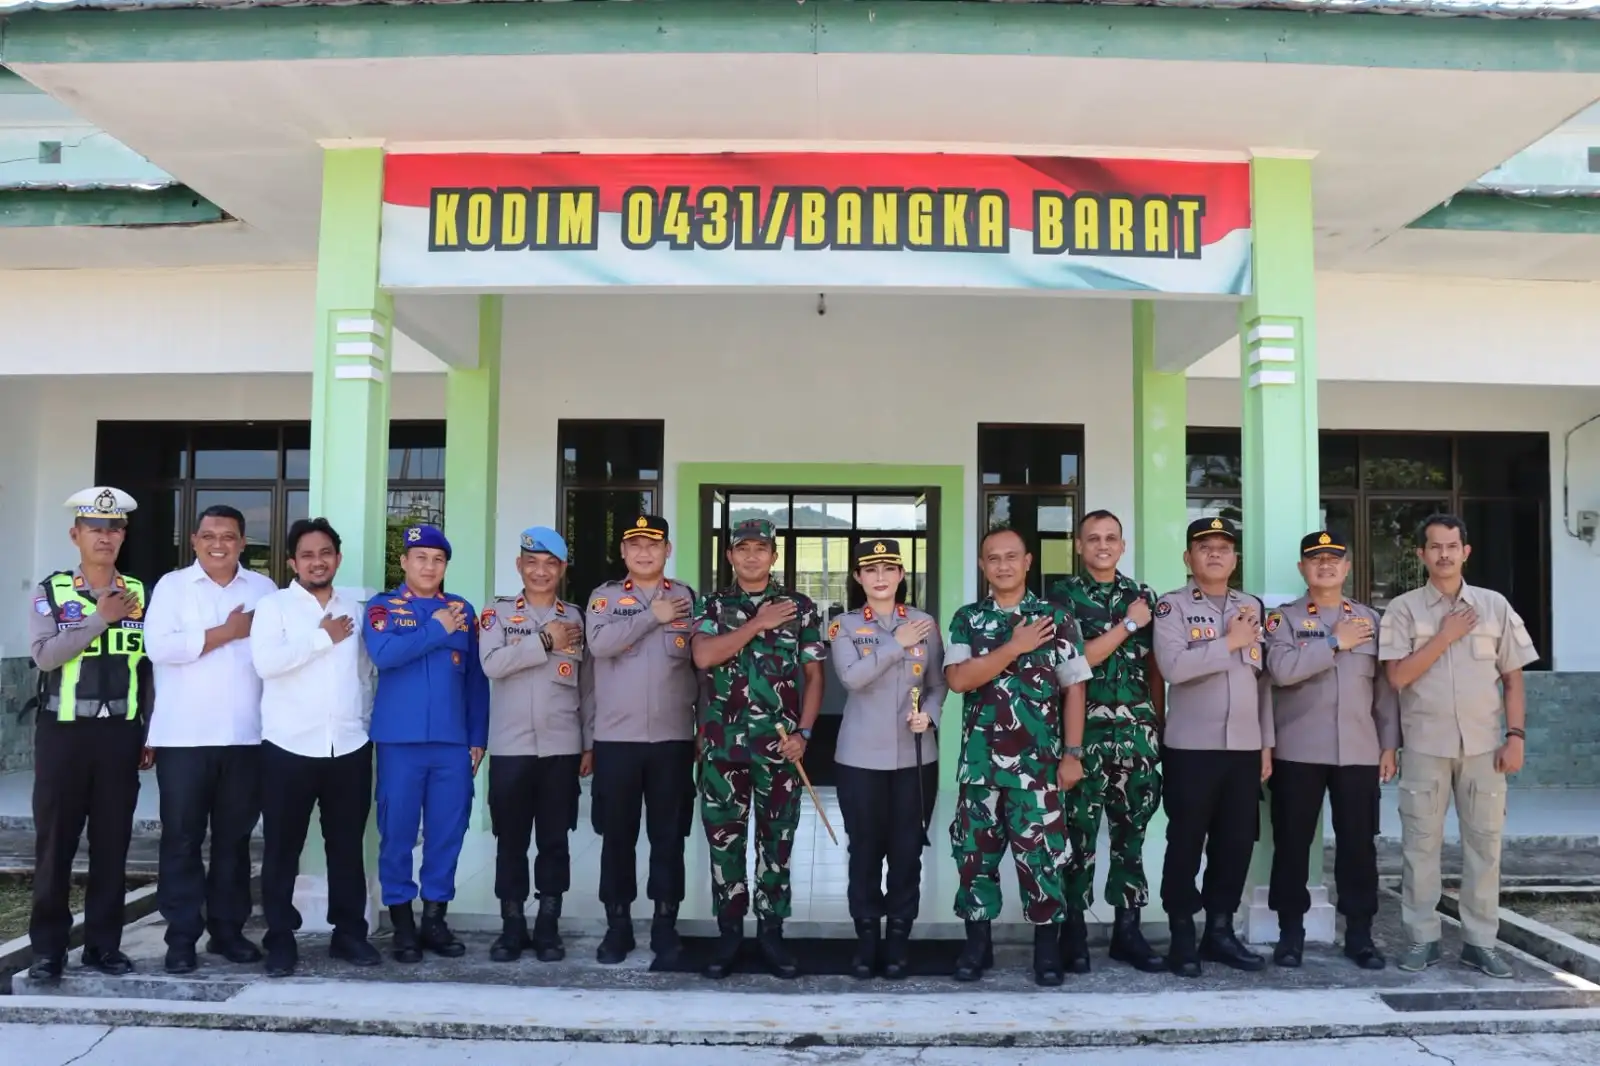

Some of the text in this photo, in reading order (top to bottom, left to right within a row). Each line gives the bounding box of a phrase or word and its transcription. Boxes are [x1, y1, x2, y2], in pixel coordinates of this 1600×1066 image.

[434, 189, 1201, 252] KODIM 0431/BANGKA BARAT
